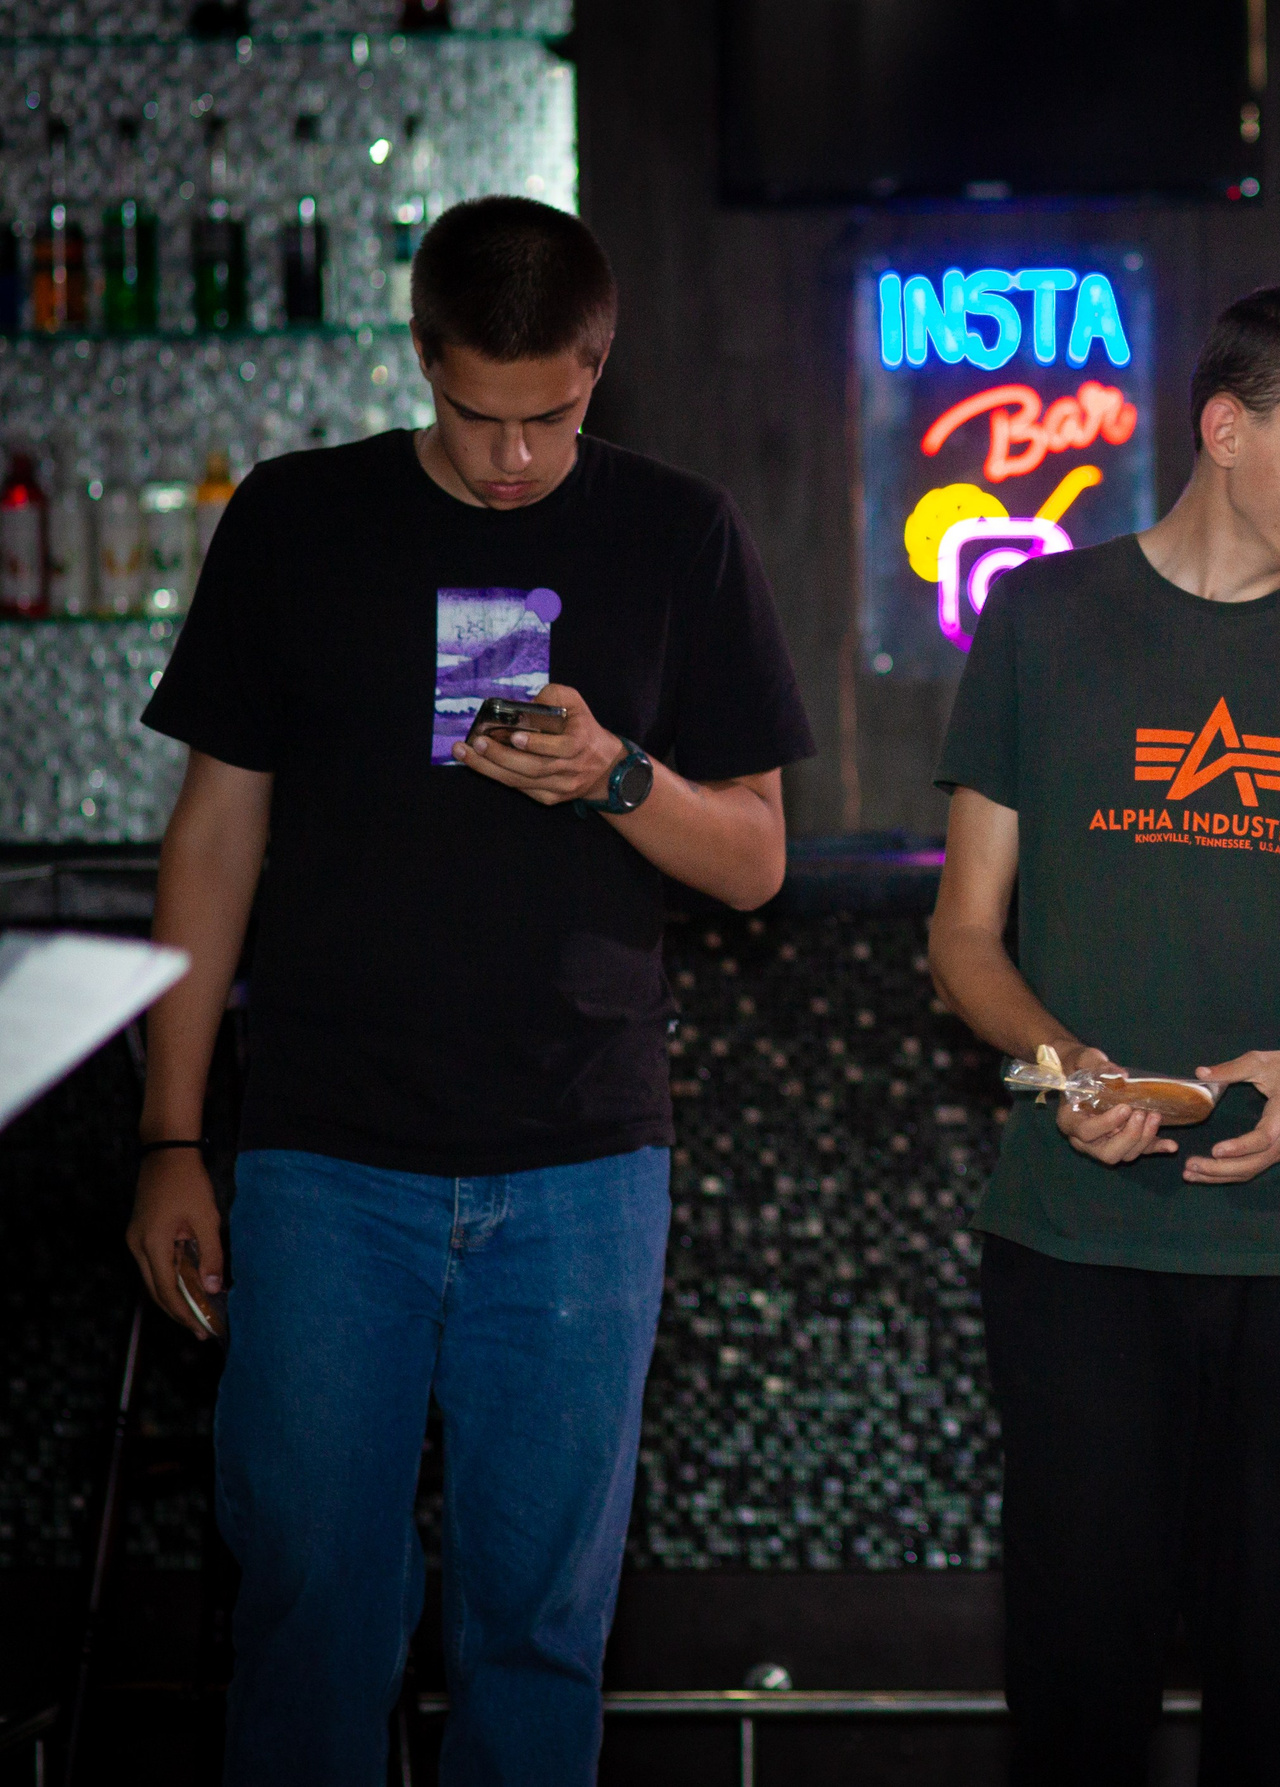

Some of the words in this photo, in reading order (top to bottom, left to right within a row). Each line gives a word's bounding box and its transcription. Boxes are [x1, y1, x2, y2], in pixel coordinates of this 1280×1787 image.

[880, 269, 1131, 370] INSTA
[921, 382, 1137, 483] Bar
[1088, 808, 1174, 831] ALPHA
[1134, 832, 1193, 846] KNOXVILLE,
[1194, 835, 1254, 851] TENNESSEE,
